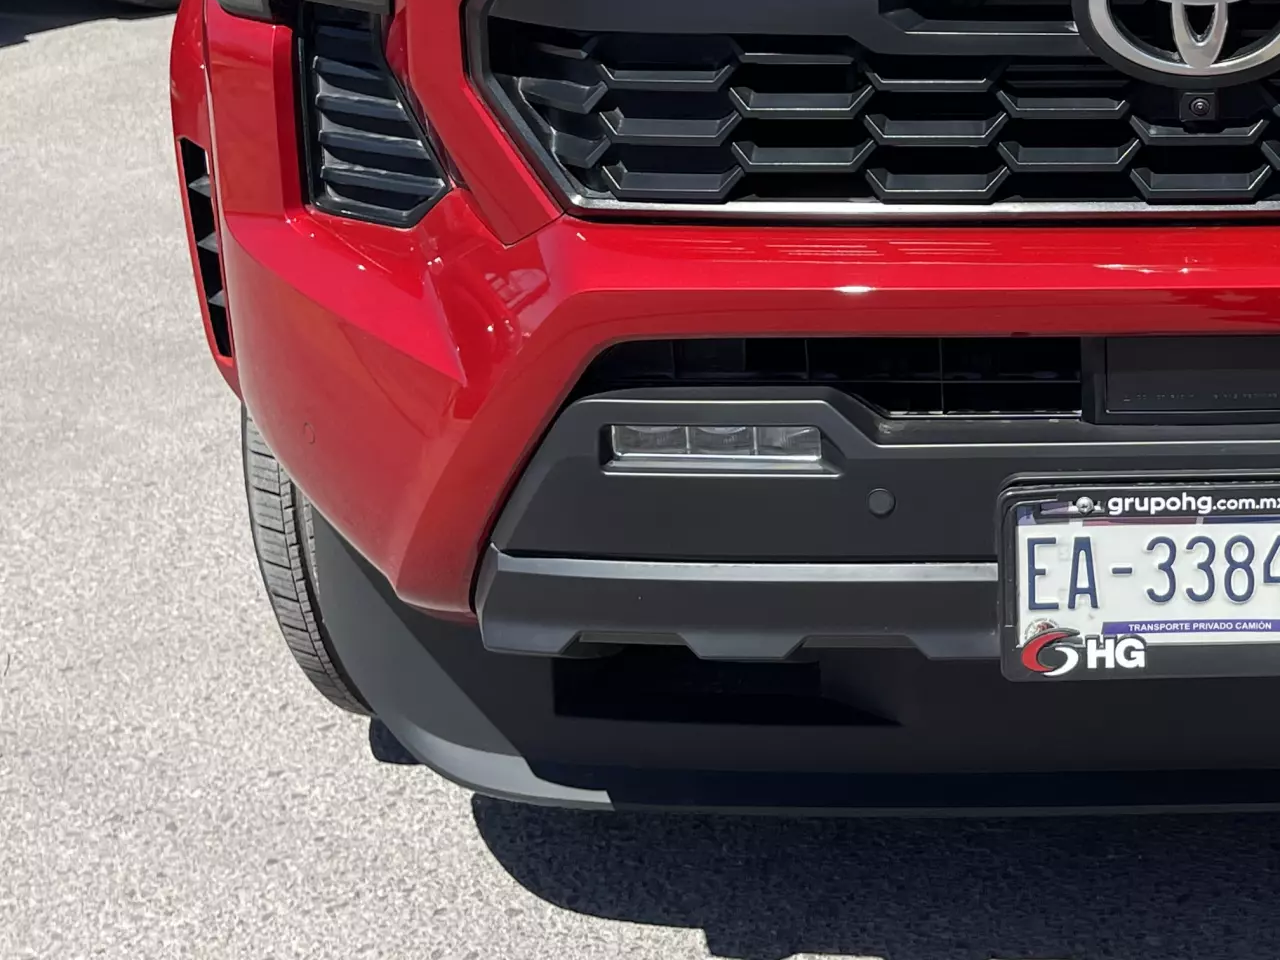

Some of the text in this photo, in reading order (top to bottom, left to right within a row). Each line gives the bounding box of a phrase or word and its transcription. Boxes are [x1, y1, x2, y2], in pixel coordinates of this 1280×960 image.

[1128, 620, 1273, 632] TRANSPORTE PRIVADO CAMIÓN
[1086, 637, 1146, 669] HG
